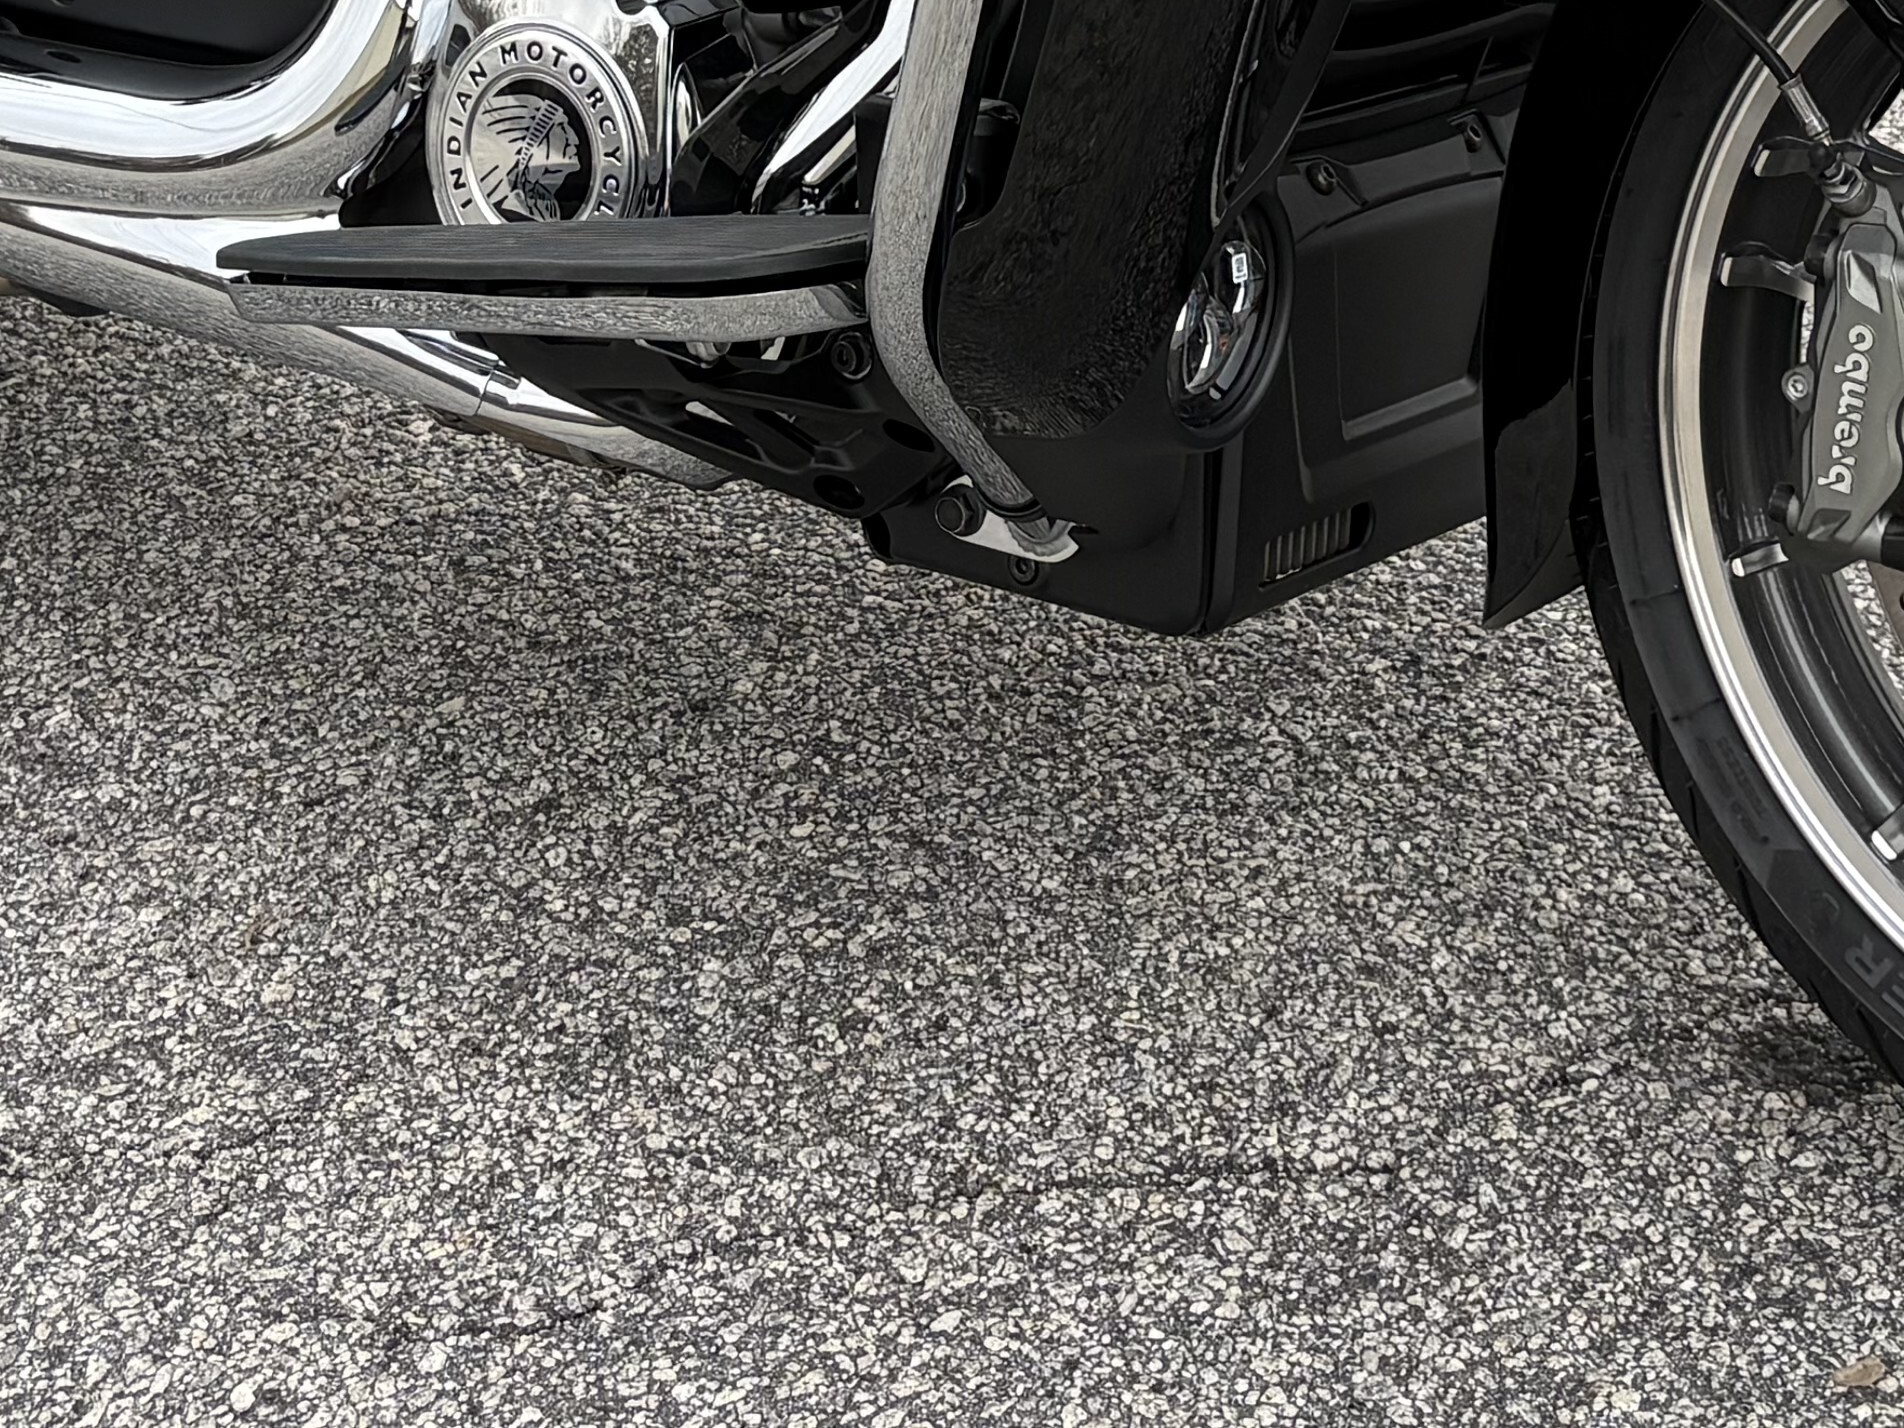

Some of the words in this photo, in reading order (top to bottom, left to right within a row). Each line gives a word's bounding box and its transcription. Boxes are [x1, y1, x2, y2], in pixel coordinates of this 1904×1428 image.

[446, 61, 488, 210] INDIAN
[498, 40, 623, 217] MOTORCYCL
[1817, 322, 1876, 495] brembo
